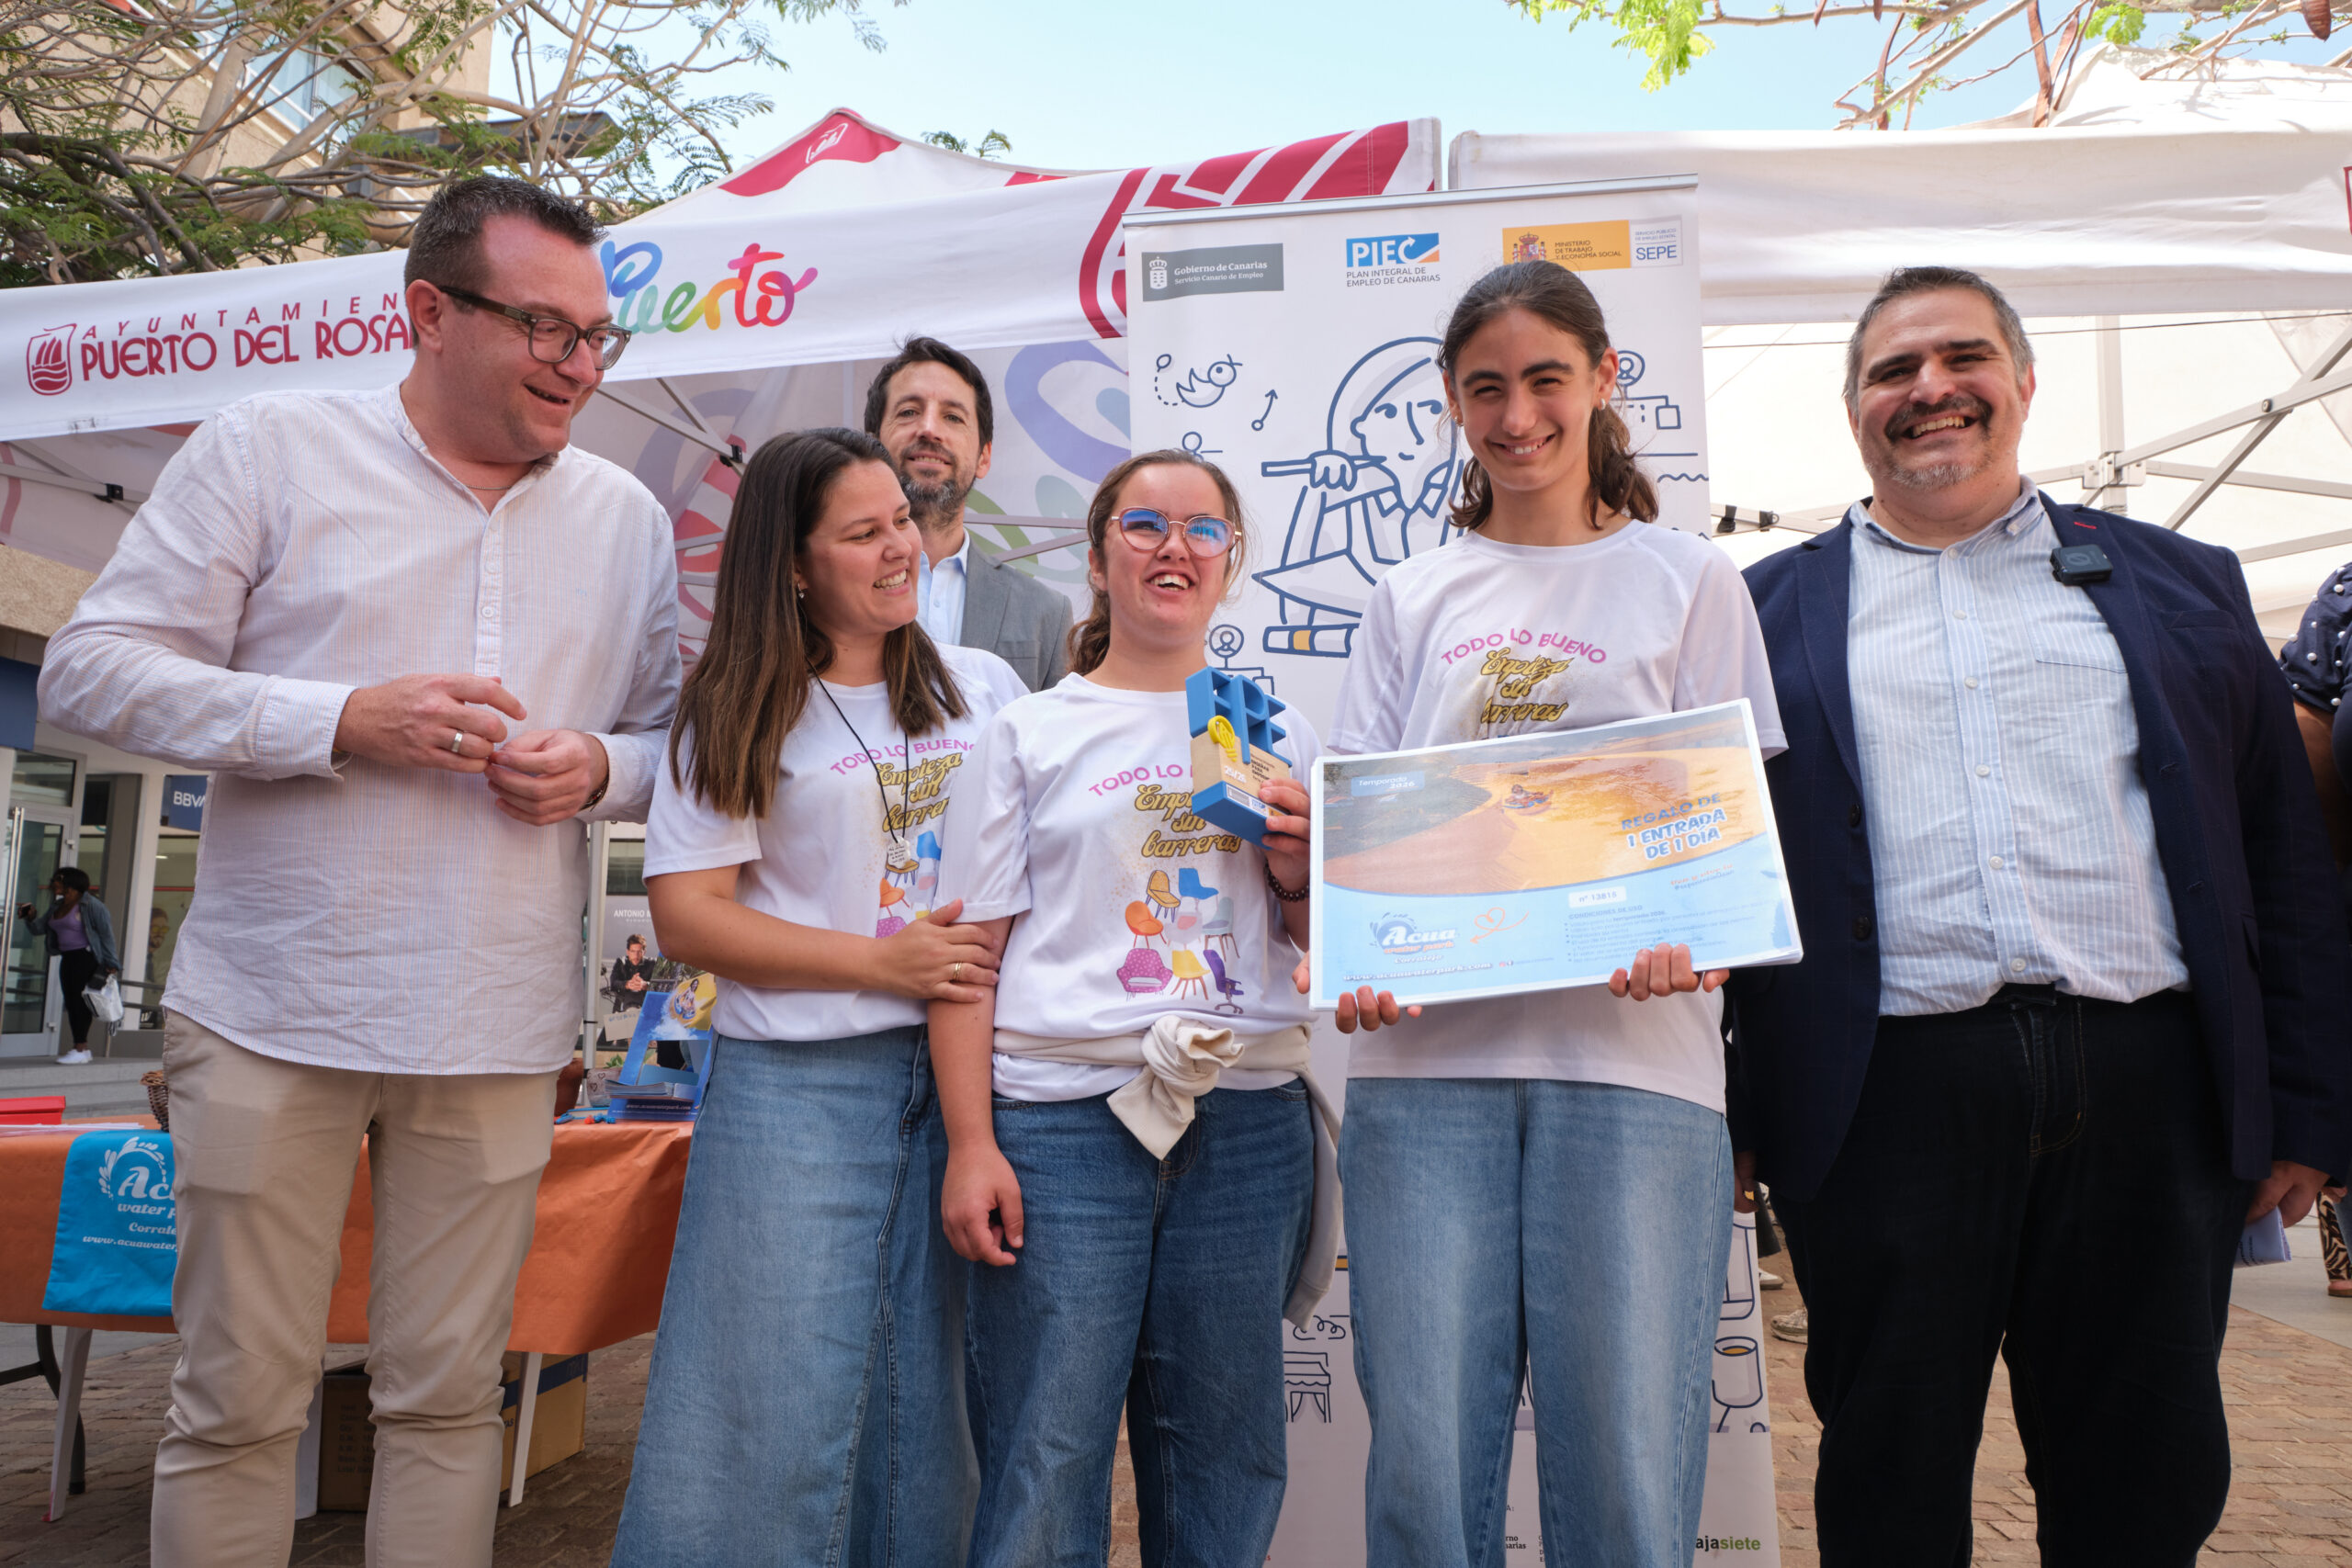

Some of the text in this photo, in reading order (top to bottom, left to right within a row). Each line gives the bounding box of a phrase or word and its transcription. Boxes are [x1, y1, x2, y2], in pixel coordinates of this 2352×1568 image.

[1352, 236, 1419, 266] PIEC
[1555, 240, 1590, 248] MINISTERIO
[1599, 250, 1623, 258] SOCIAL
[1636, 244, 1678, 261] SEPE
[1174, 261, 1268, 276] Gobierno de Canarias
[1174, 276, 1201, 285] Servicio
[1202, 274, 1227, 282] Canario
[1238, 271, 1264, 280] Empleo
[1371, 267, 1413, 277] INTEGRAL
[1415, 266, 1426, 275] DE
[600, 241, 818, 334] Puerto
[1346, 274, 1441, 288] EMPLEO DE CANARIAS
[82, 292, 398, 340] AYUNTAMIEN
[81, 332, 217, 381] PUERTO
[234, 324, 300, 367] DEL
[1441, 628, 1607, 665] TODO LO BUENO
[831, 749, 882, 775] TODO
[885, 745, 908, 757] LO
[876, 752, 963, 795] Empieza
[1089, 767, 1150, 796] TODO
[1156, 764, 1183, 779] LO
[909, 777, 936, 804] sin
[1622, 793, 1721, 830] REGALO DE
[1640, 808, 1725, 843] ENTRADA
[1141, 829, 1243, 858] barreras
[1645, 841, 1670, 859] DE
[1687, 826, 1721, 847] DÍA
[614, 909, 645, 918] ANTONIO
[1382, 926, 1456, 946] Acua
[118, 1203, 166, 1215] water
[129, 1222, 177, 1235] Corrale
[83, 1235, 178, 1253] www.acuawater
[1695, 1535, 1761, 1551] ajasiete
